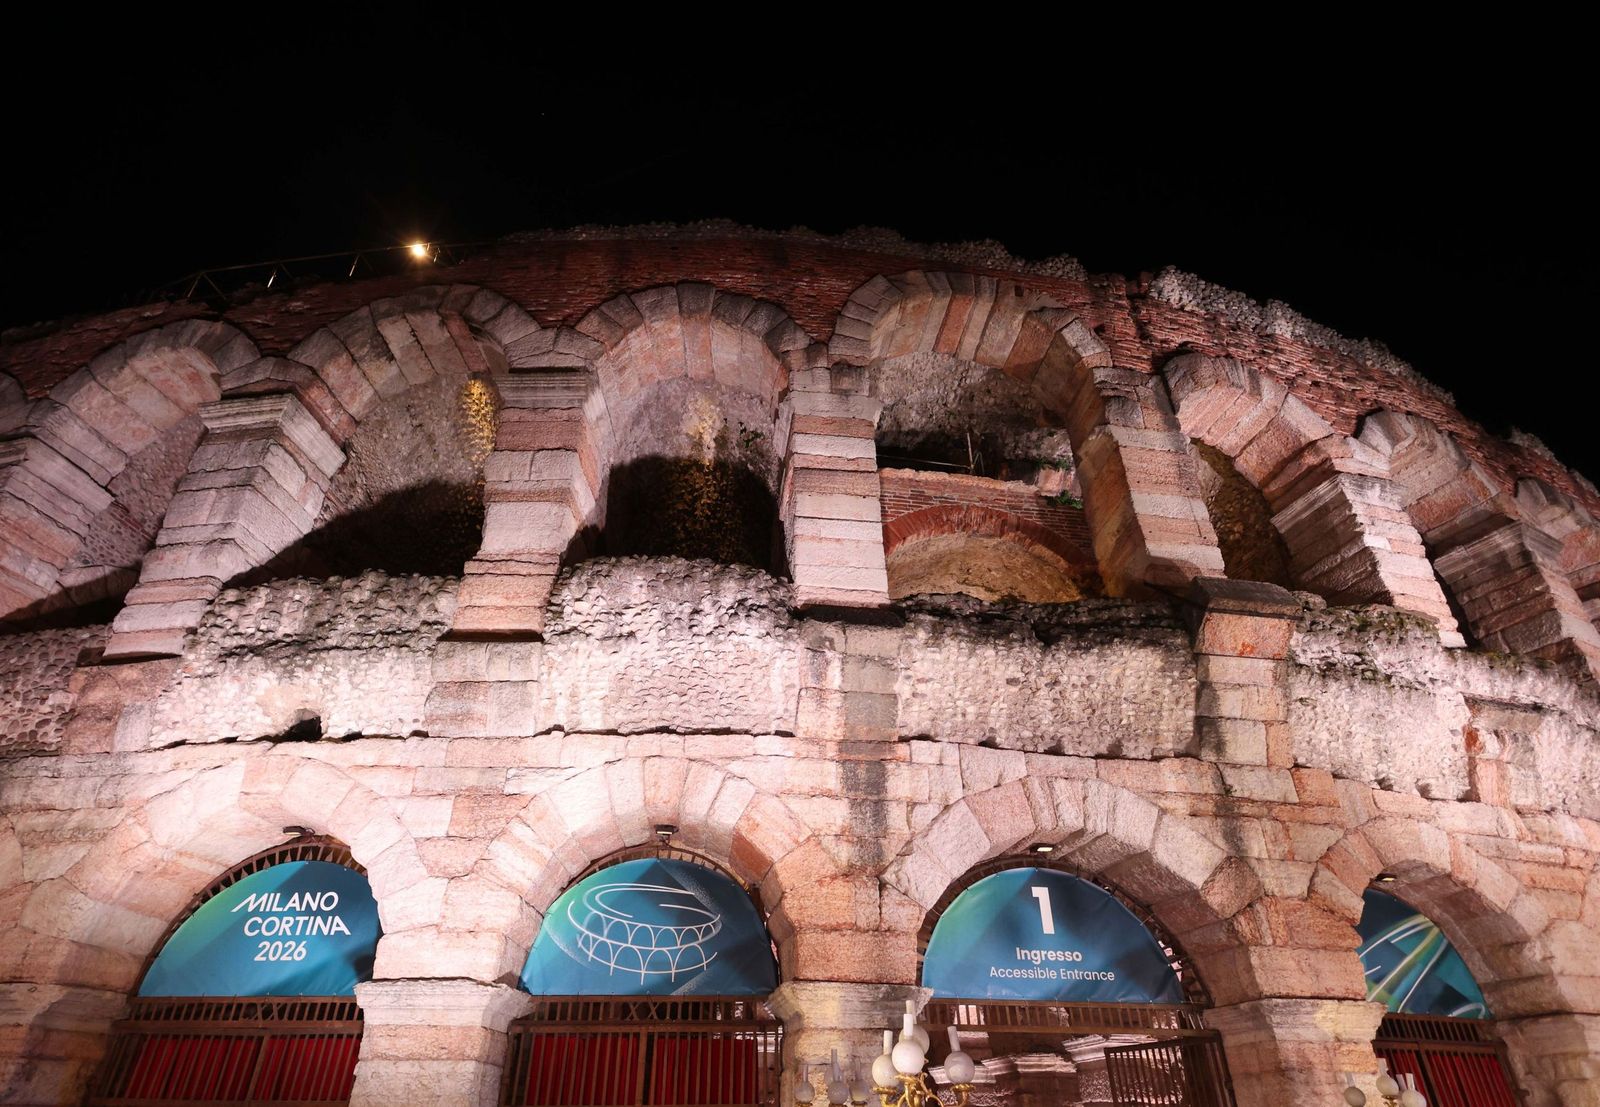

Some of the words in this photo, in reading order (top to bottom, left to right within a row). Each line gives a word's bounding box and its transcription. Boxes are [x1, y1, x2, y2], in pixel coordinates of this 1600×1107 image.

[231, 891, 339, 913] MILANO
[1031, 886, 1055, 935] 1
[243, 915, 351, 937] CORTINA
[253, 940, 308, 962] 2026
[1015, 947, 1082, 965] Ingresso
[989, 966, 1058, 980] Accessible
[1060, 968, 1115, 982] Entrance
